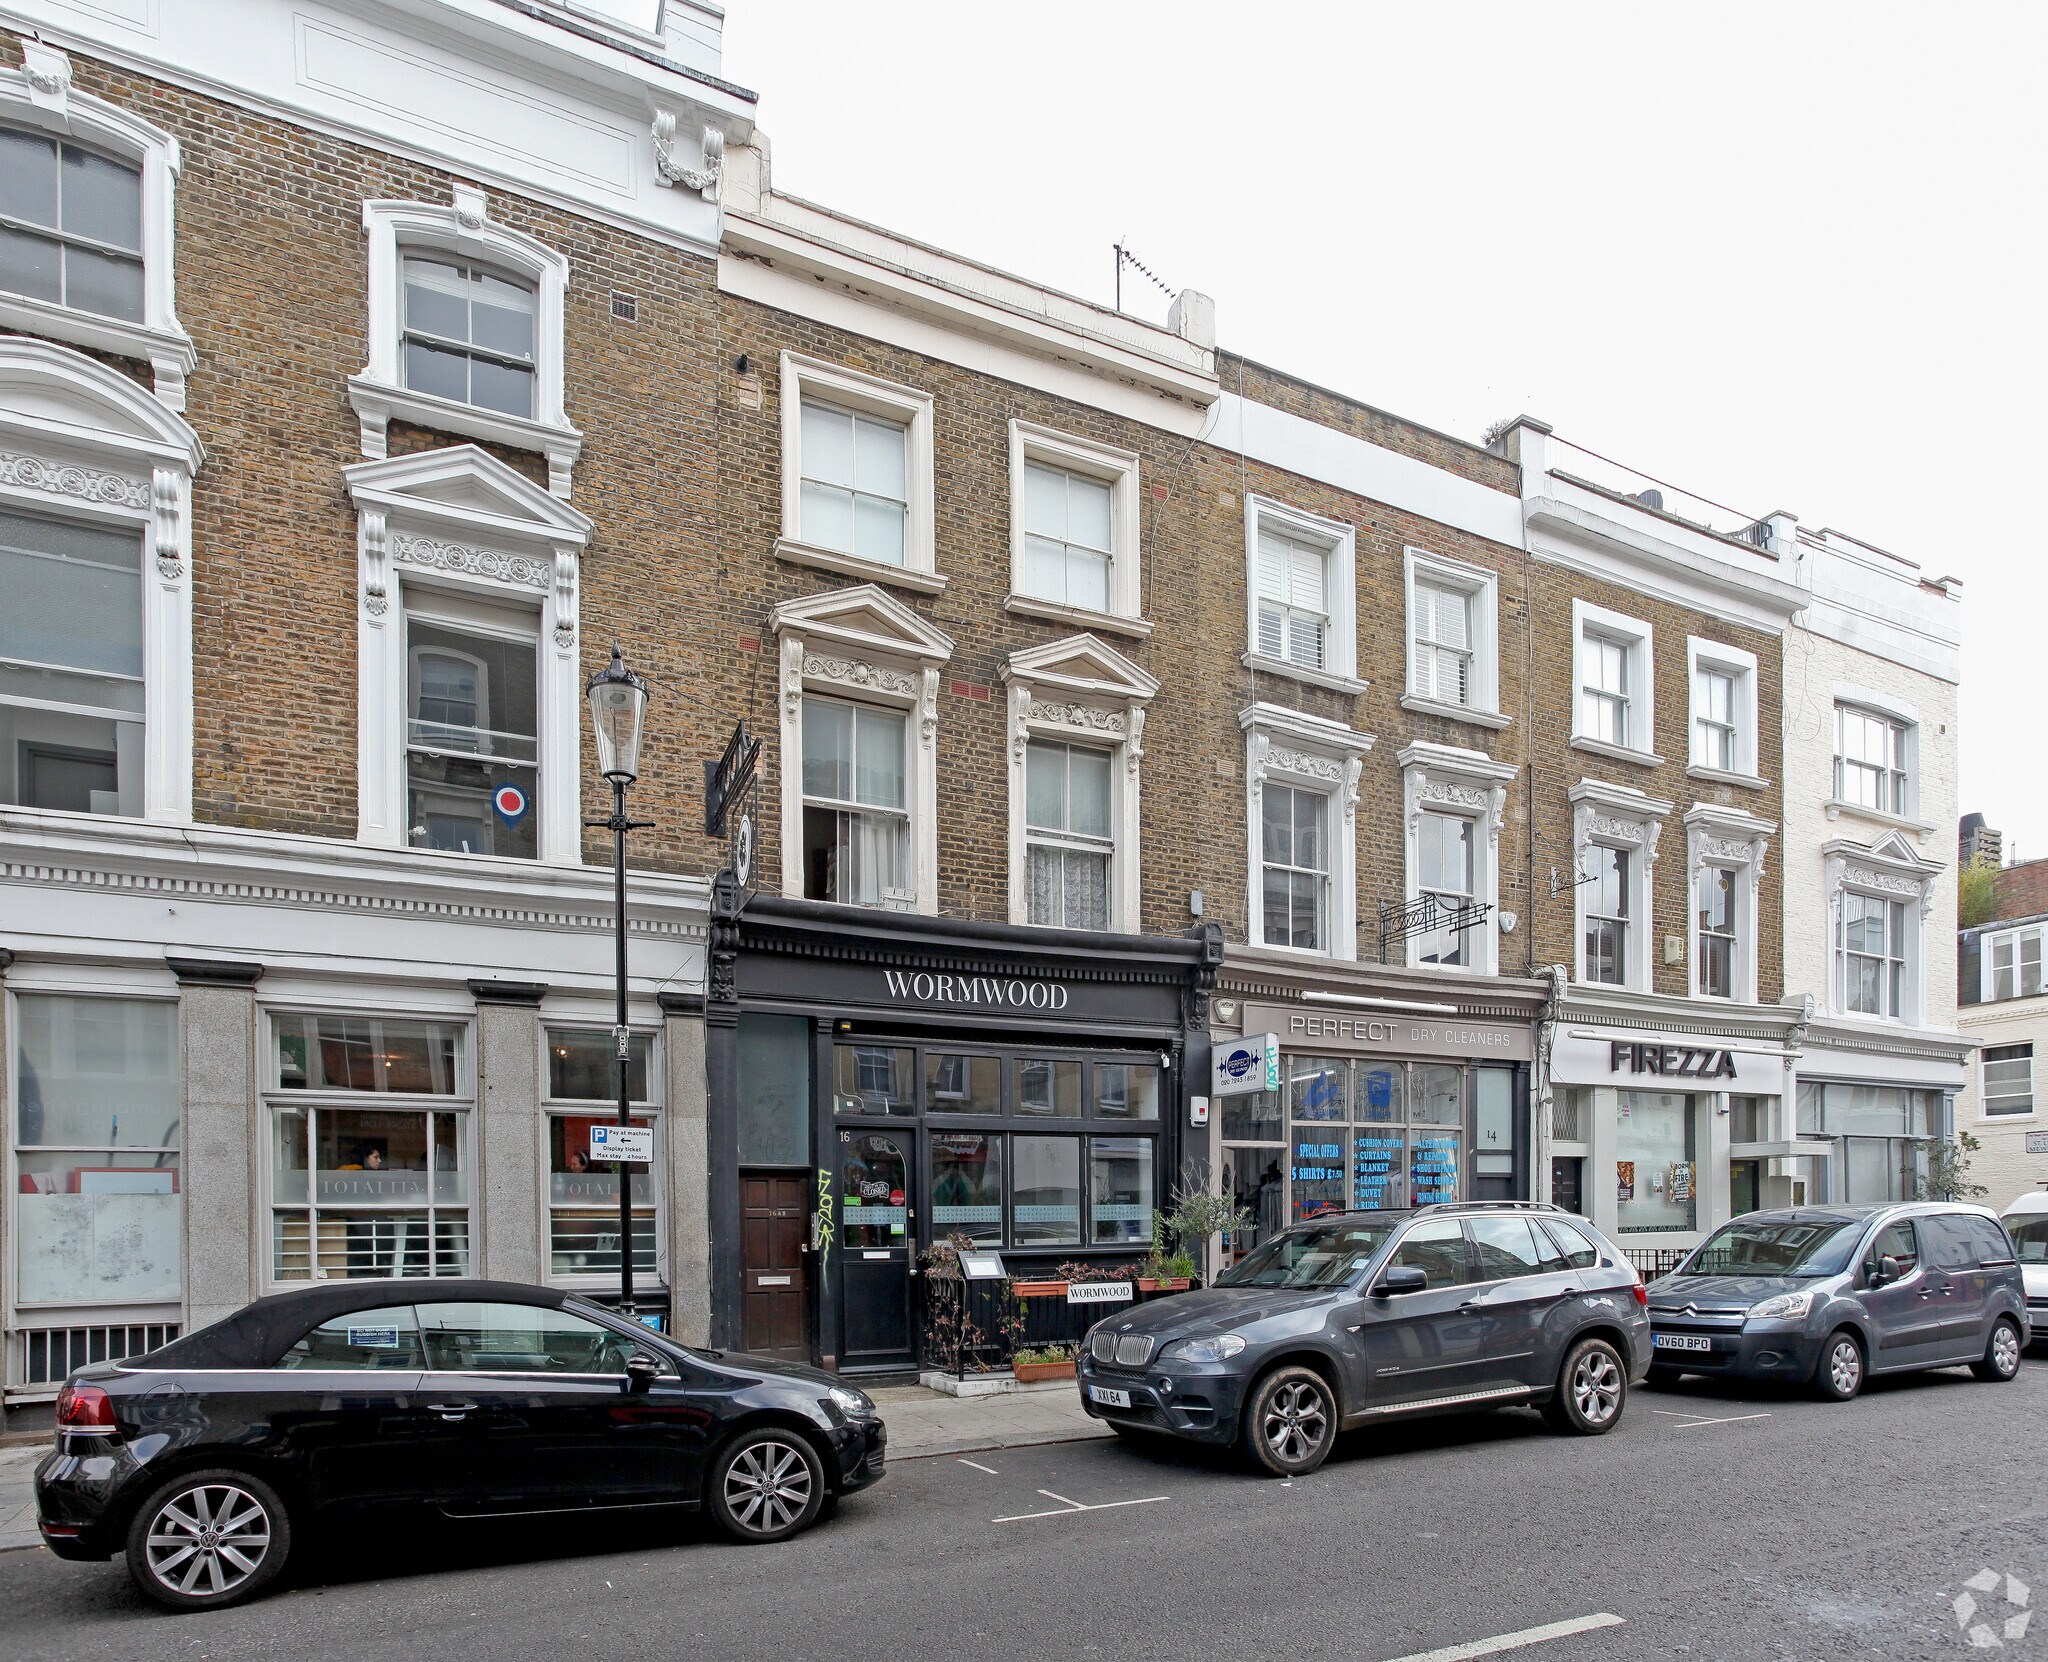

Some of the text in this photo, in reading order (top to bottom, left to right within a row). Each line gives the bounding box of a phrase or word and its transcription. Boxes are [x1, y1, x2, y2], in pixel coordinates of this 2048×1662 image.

[883, 970, 1068, 1010] WORMWOOD
[1290, 1015, 1510, 1047] PERFECT DRY CLEANERS
[1228, 1056, 1250, 1069] PERFECT
[1610, 1040, 1738, 1079] FIREZZA
[594, 1129, 605, 1142] P
[840, 1131, 851, 1143] 16
[1487, 1129, 1497, 1142] 14
[1358, 1138, 1403, 1148] CUSHION COVERS
[1300, 1143, 1339, 1158] SPECIAL OFFERS
[1360, 1151, 1392, 1160] CURTAINS
[1417, 1152, 1423, 1160] &
[1291, 1166, 1297, 1181] 5
[1298, 1167, 1325, 1180] SHIRTS
[1360, 1163, 1390, 1172] BLANKET
[1360, 1175, 1387, 1185] LEATHER
[1417, 1175, 1433, 1185] WASH
[1675, 1173, 1689, 1182] FIRE
[1361, 1188, 1382, 1198] DUVET
[1361, 1201, 1379, 1209] RUGS
[1070, 1286, 1130, 1299] WORMWOOD
[1658, 1336, 1708, 1349] OV60 BPO
